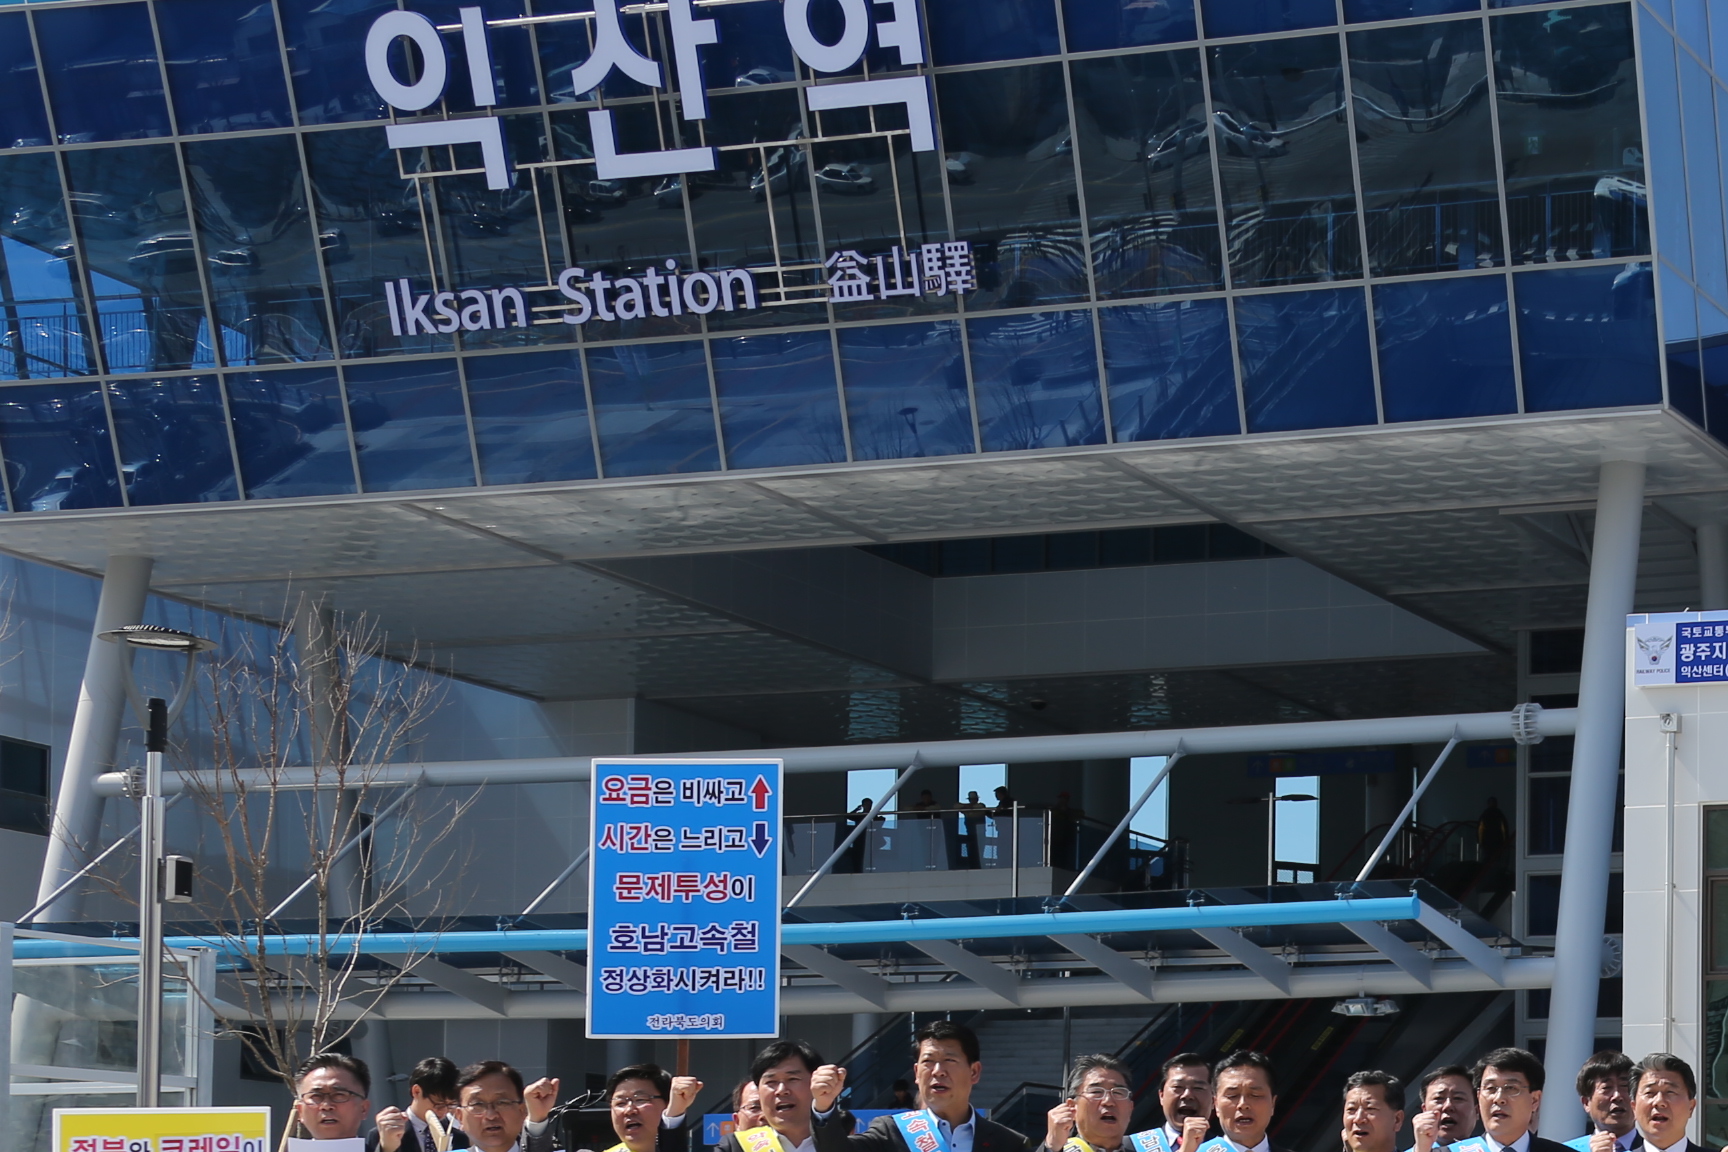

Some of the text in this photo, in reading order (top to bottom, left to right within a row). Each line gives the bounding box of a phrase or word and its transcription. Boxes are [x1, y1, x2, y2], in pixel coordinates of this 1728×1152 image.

[365, 0, 936, 190] 익산역
[385, 279, 527, 337] Iksan
[558, 258, 757, 326] Station
[601, 775, 746, 806] 요금은 비싸고
[600, 822, 747, 853] 시간은 느리고
[614, 872, 755, 903] 문제투성이
[608, 922, 759, 954] 호남고속철
[601, 966, 765, 994] 정상화시켜라!!
[647, 1014, 724, 1031] 전라북도의회
